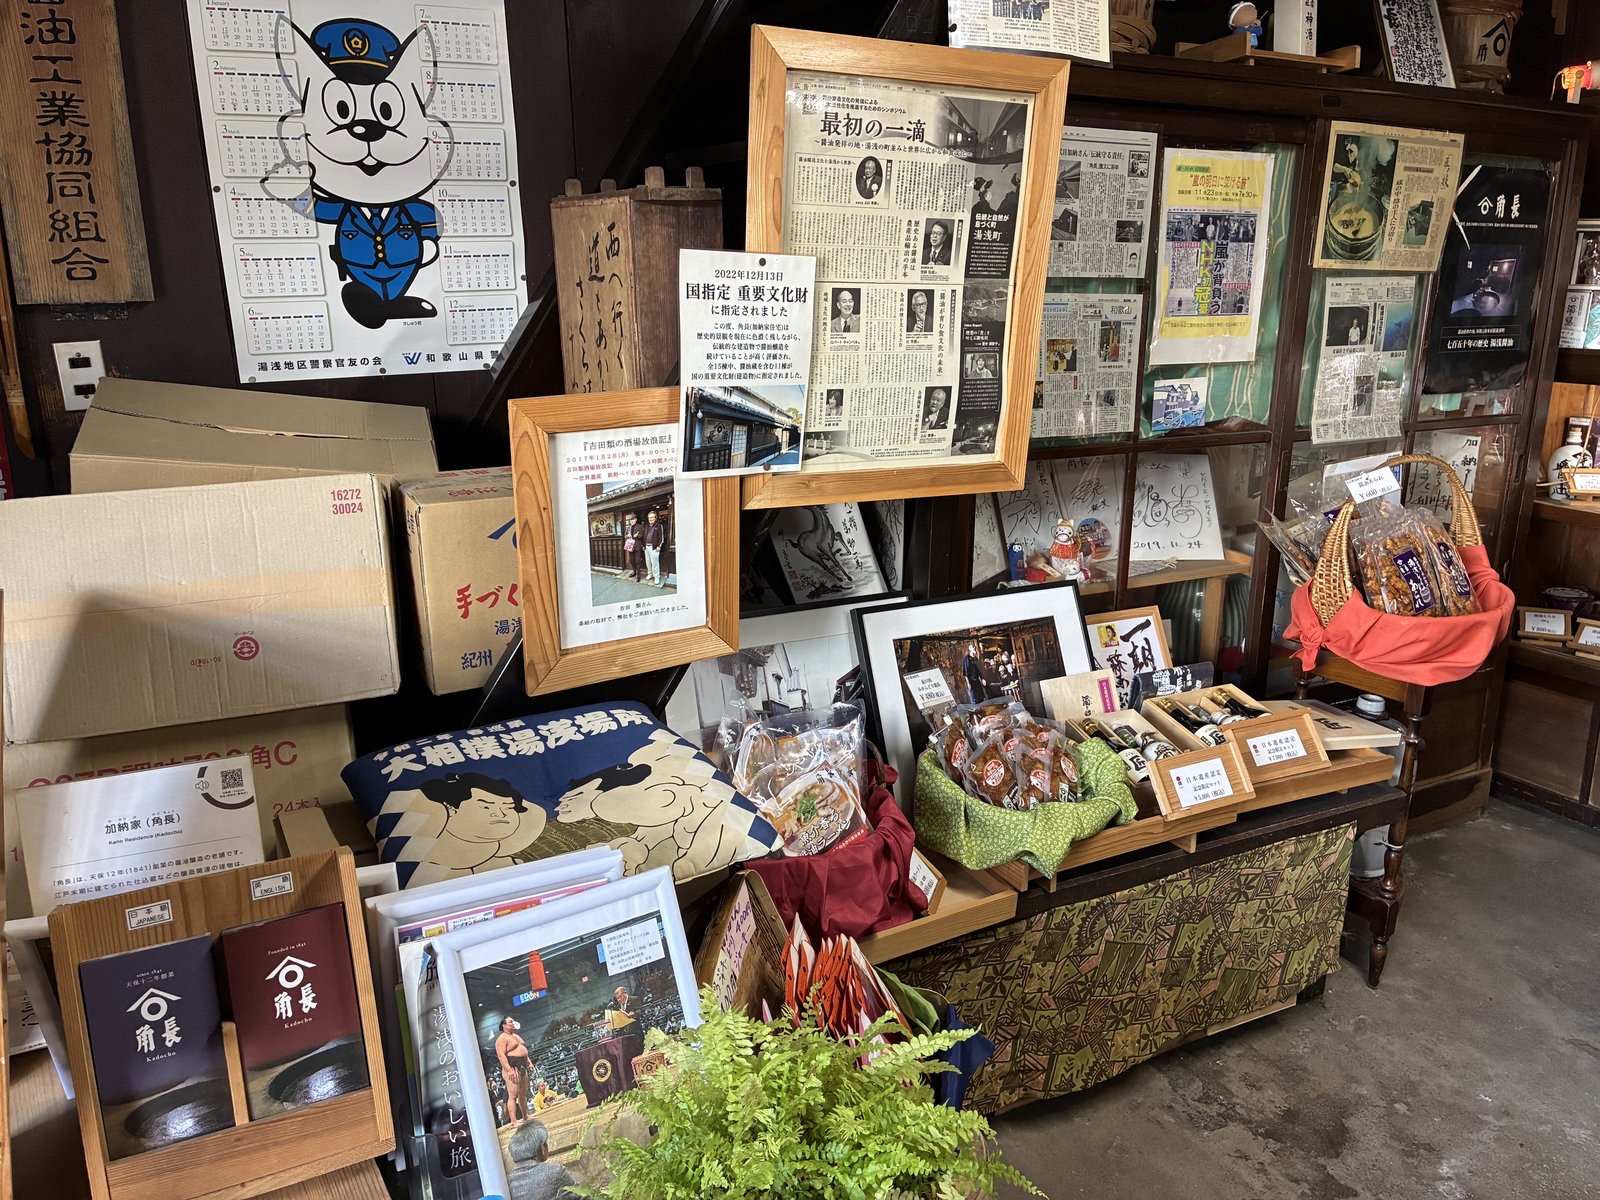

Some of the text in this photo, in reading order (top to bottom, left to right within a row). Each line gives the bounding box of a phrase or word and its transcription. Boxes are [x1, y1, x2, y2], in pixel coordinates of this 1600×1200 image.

[420, 9, 425, 18] 7
[213, 60, 219, 70] 2
[426, 71, 432, 80] 8
[222, 124, 228, 134] 3
[820, 111, 926, 143] 最初の一滴
[20, 0, 109, 281] 油工業協同組合
[432, 130, 438, 139] 9
[230, 187, 236, 196] 4
[438, 189, 448, 198] 10
[1495, 193, 1521, 220] 角長
[975, 213, 1010, 222] 伝統と自然が
[974, 220, 997, 229] 息づく町
[973, 229, 1002, 242] 湯浅町
[240, 248, 245, 256] 5
[444, 246, 452, 254] 11
[714, 269, 784, 281] 2022年12月13日
[1210, 241, 1229, 315] 嵐が背負う
[685, 282, 809, 303] 国指定 重要文化財
[449, 300, 458, 308] 12
[711, 304, 789, 317] に指定されました
[248, 306, 254, 316] 6
[1447, 337, 1489, 350] 七百五十年の歴史
[257, 356, 383, 372] 湯浅地区警察官友の会
[330, 488, 362, 502] 16272
[332, 502, 364, 516] 30024
[461, 649, 493, 670] 紀州
[380, 708, 654, 784] 大相撲湯浅場所
[1186, 770, 1222, 782] 日本遺産認定
[799, 808, 840, 846] 魚介香る
[124, 834, 154, 843] Residence
[260, 884, 286, 896] ENGLISH
[130, 905, 168, 918] 日本語
[135, 914, 166, 926] JAPANESE
[267, 946, 290, 956] Founded
[273, 982, 318, 1020] 角長
[284, 1016, 314, 1030] Kadocho
[135, 1016, 183, 1054] 角長
[146, 1050, 178, 1063] Kadocho
[432, 1006, 472, 1169] 湯浅のおいしい旅
